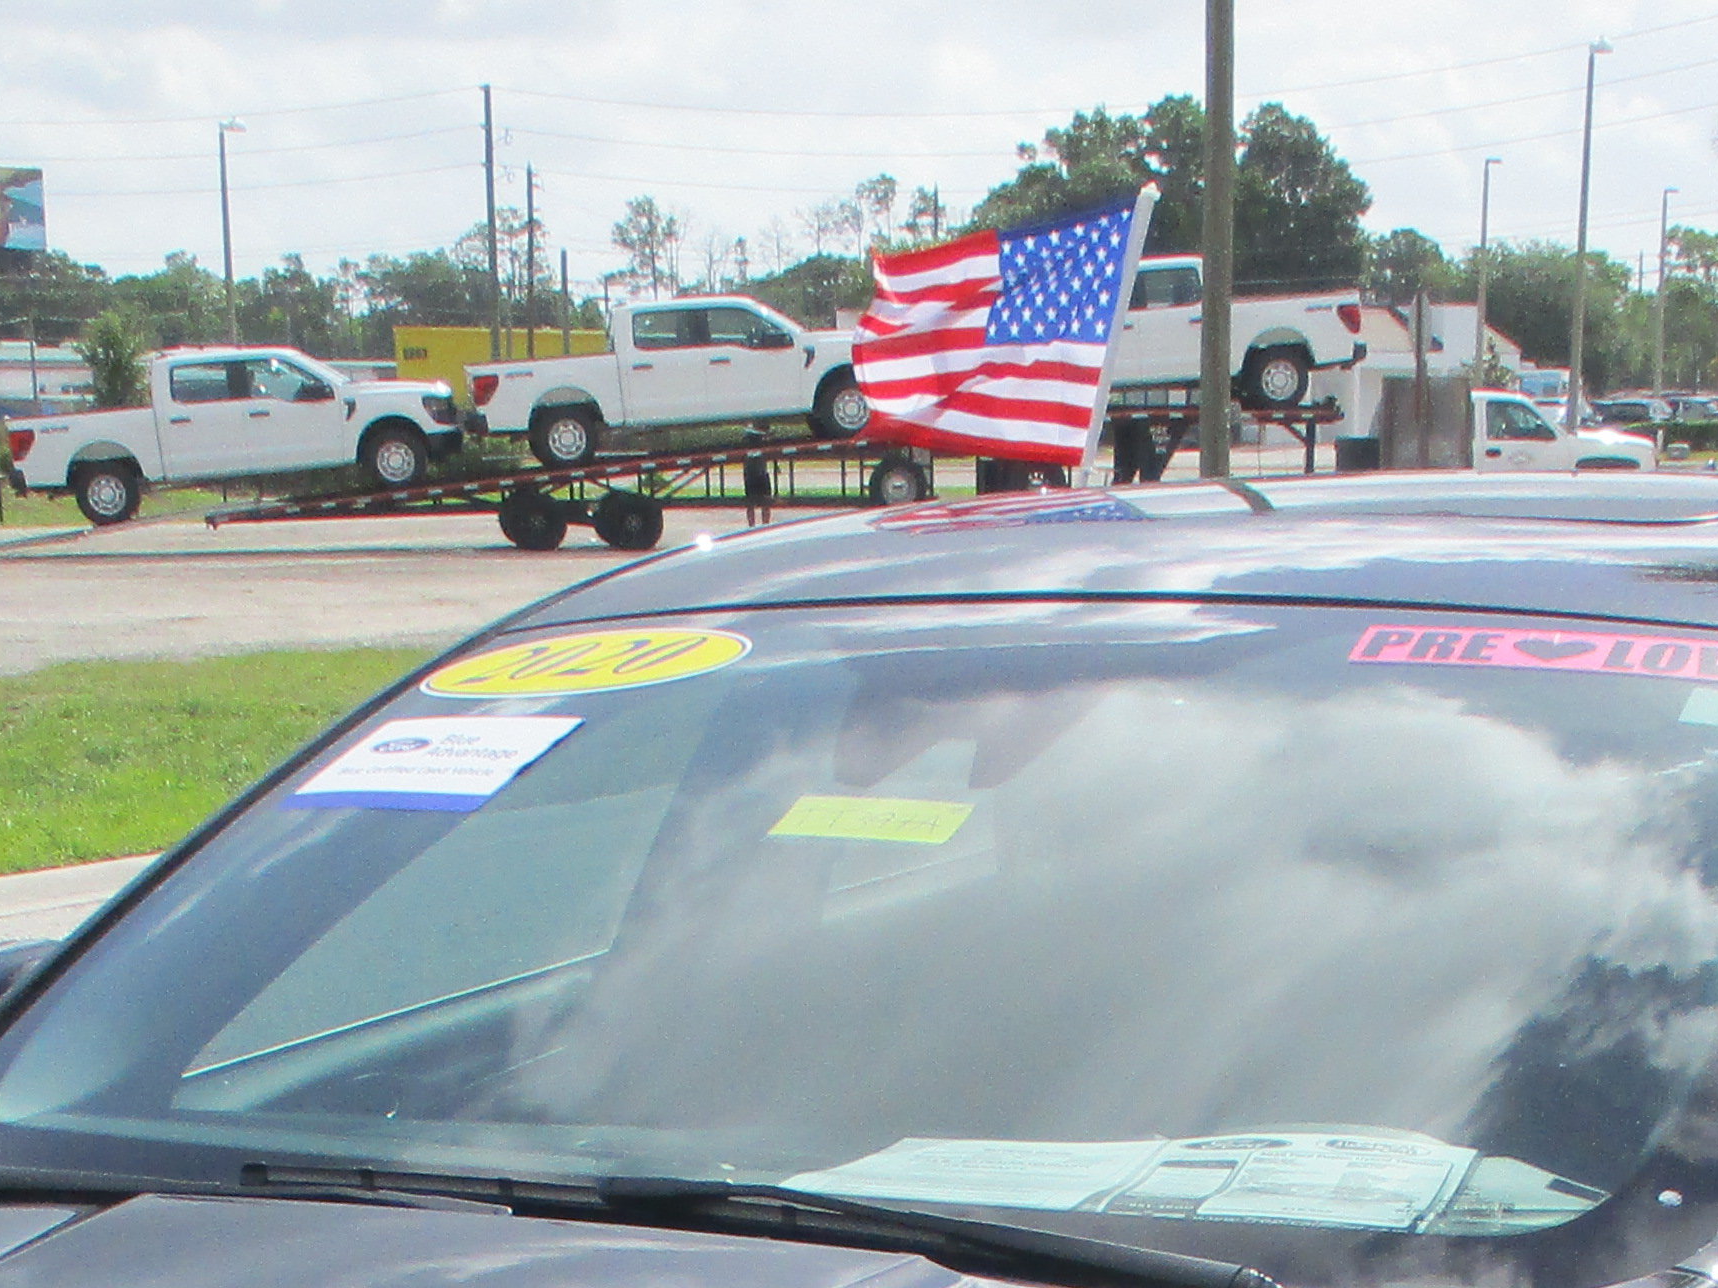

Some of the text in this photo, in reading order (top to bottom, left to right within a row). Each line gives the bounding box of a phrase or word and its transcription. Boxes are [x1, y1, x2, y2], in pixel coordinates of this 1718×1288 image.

[1361, 628, 1505, 661] PRE
[450, 637, 709, 686] 2020
[441, 734, 481, 746] Blue
[426, 746, 519, 761] Advantage
